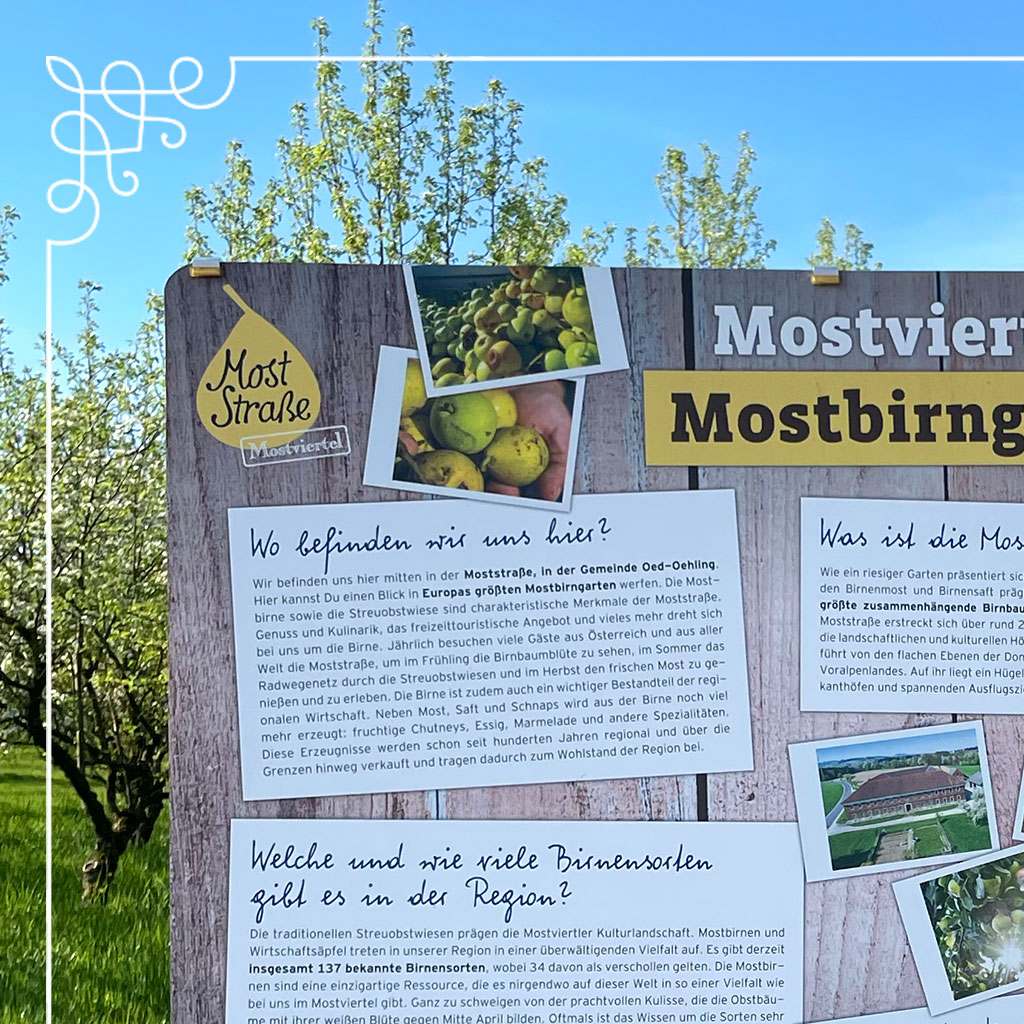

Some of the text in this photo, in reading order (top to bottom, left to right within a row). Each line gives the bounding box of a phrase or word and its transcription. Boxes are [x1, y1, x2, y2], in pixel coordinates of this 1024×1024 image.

[205, 348, 293, 391] Most
[211, 385, 311, 428] Straße
[248, 431, 344, 460] Mostviertel
[250, 517, 612, 575] Wo befinden wir uns hier?
[820, 517, 867, 548] Was
[881, 522, 916, 550] ist
[928, 523, 968, 549] die
[252, 560, 719, 589] Wir befinden uns hier mitten in der Moststraße, in der Gemeinde Oed-Oehling.
[820, 599, 857, 612] größte
[863, 601, 977, 614] zusammenhängende
[820, 681, 875, 692] kanthöfen
[878, 682, 898, 692] und
[901, 683, 965, 694] spannenden
[251, 839, 713, 873] Welche und wie viele Birnensorten
[250, 876, 572, 924] gibt es in der Region?
[249, 961, 784, 976] insgesamt 137 bekannte Birnensorten, wobei 34 davon als verschollen gelten. Die Mostbir-
